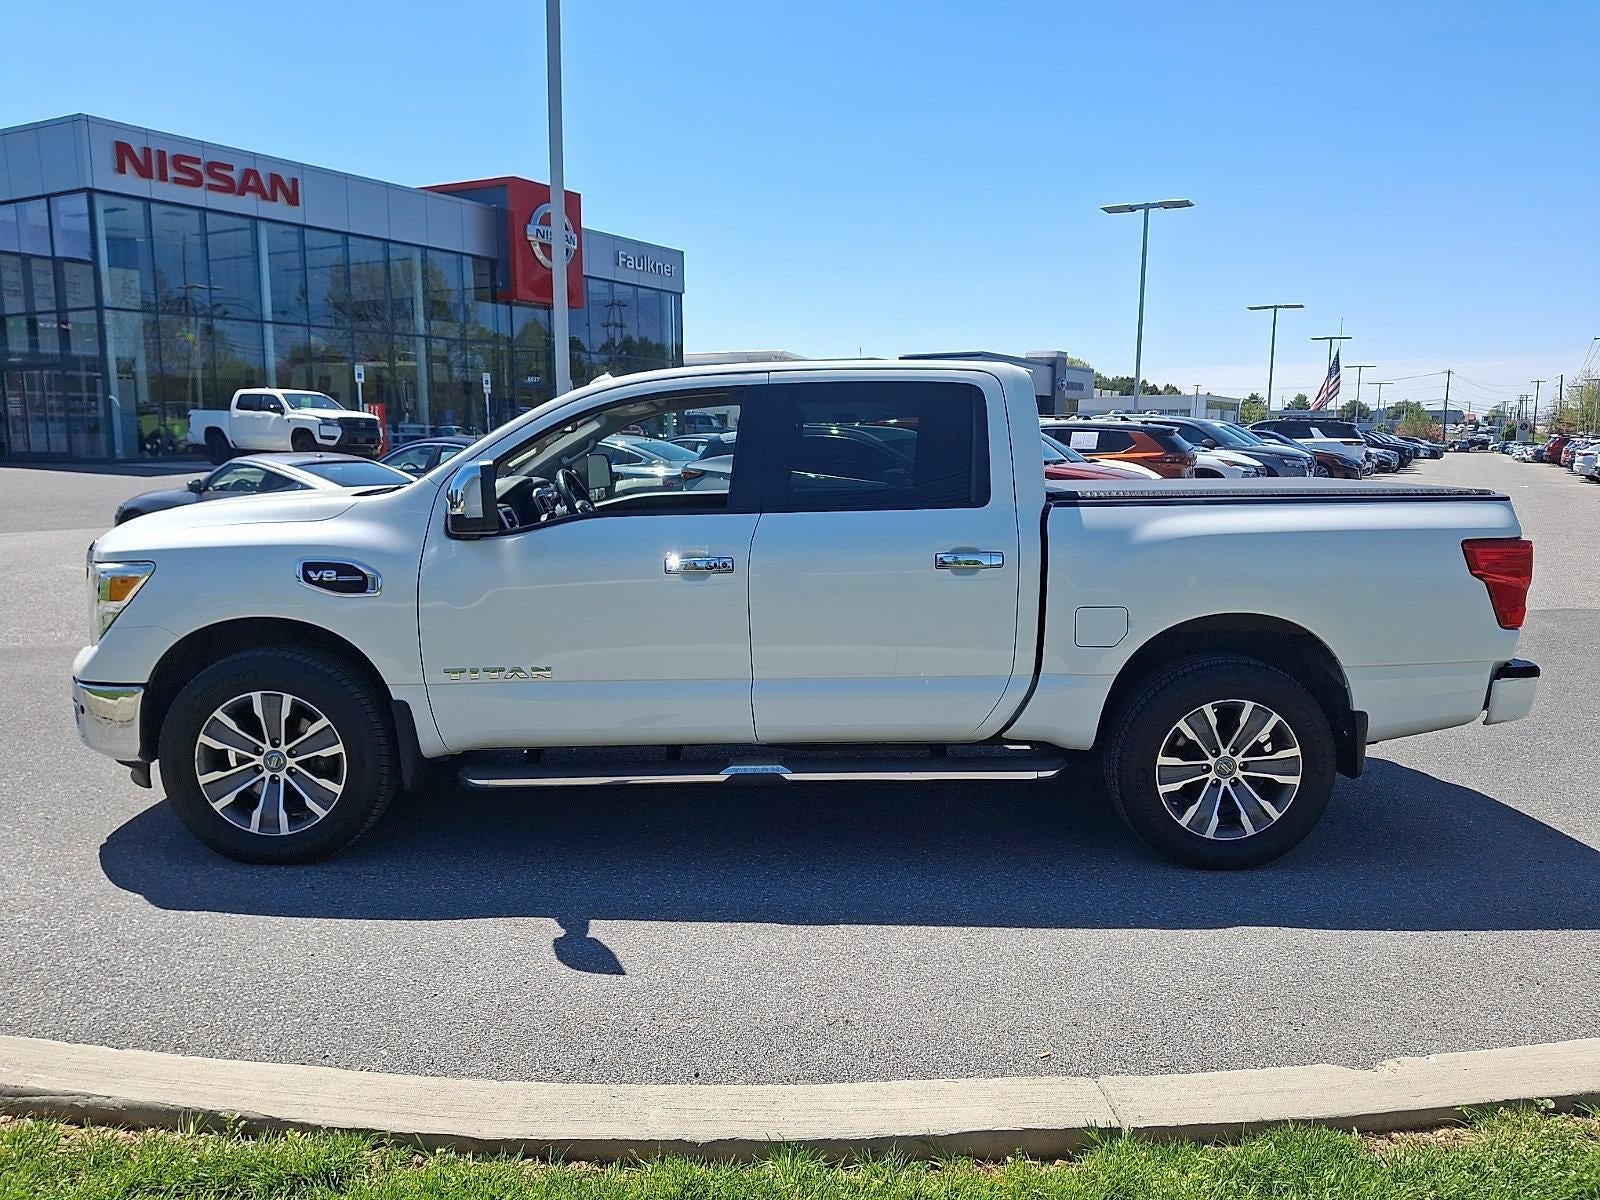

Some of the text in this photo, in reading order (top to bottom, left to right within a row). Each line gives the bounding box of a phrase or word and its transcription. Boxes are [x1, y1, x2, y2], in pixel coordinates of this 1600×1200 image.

[114, 140, 300, 206] NISSAN
[535, 228, 576, 246] NIAN
[617, 250, 677, 277] Faulkner
[307, 569, 337, 581] V8
[443, 666, 552, 680] TITAN
